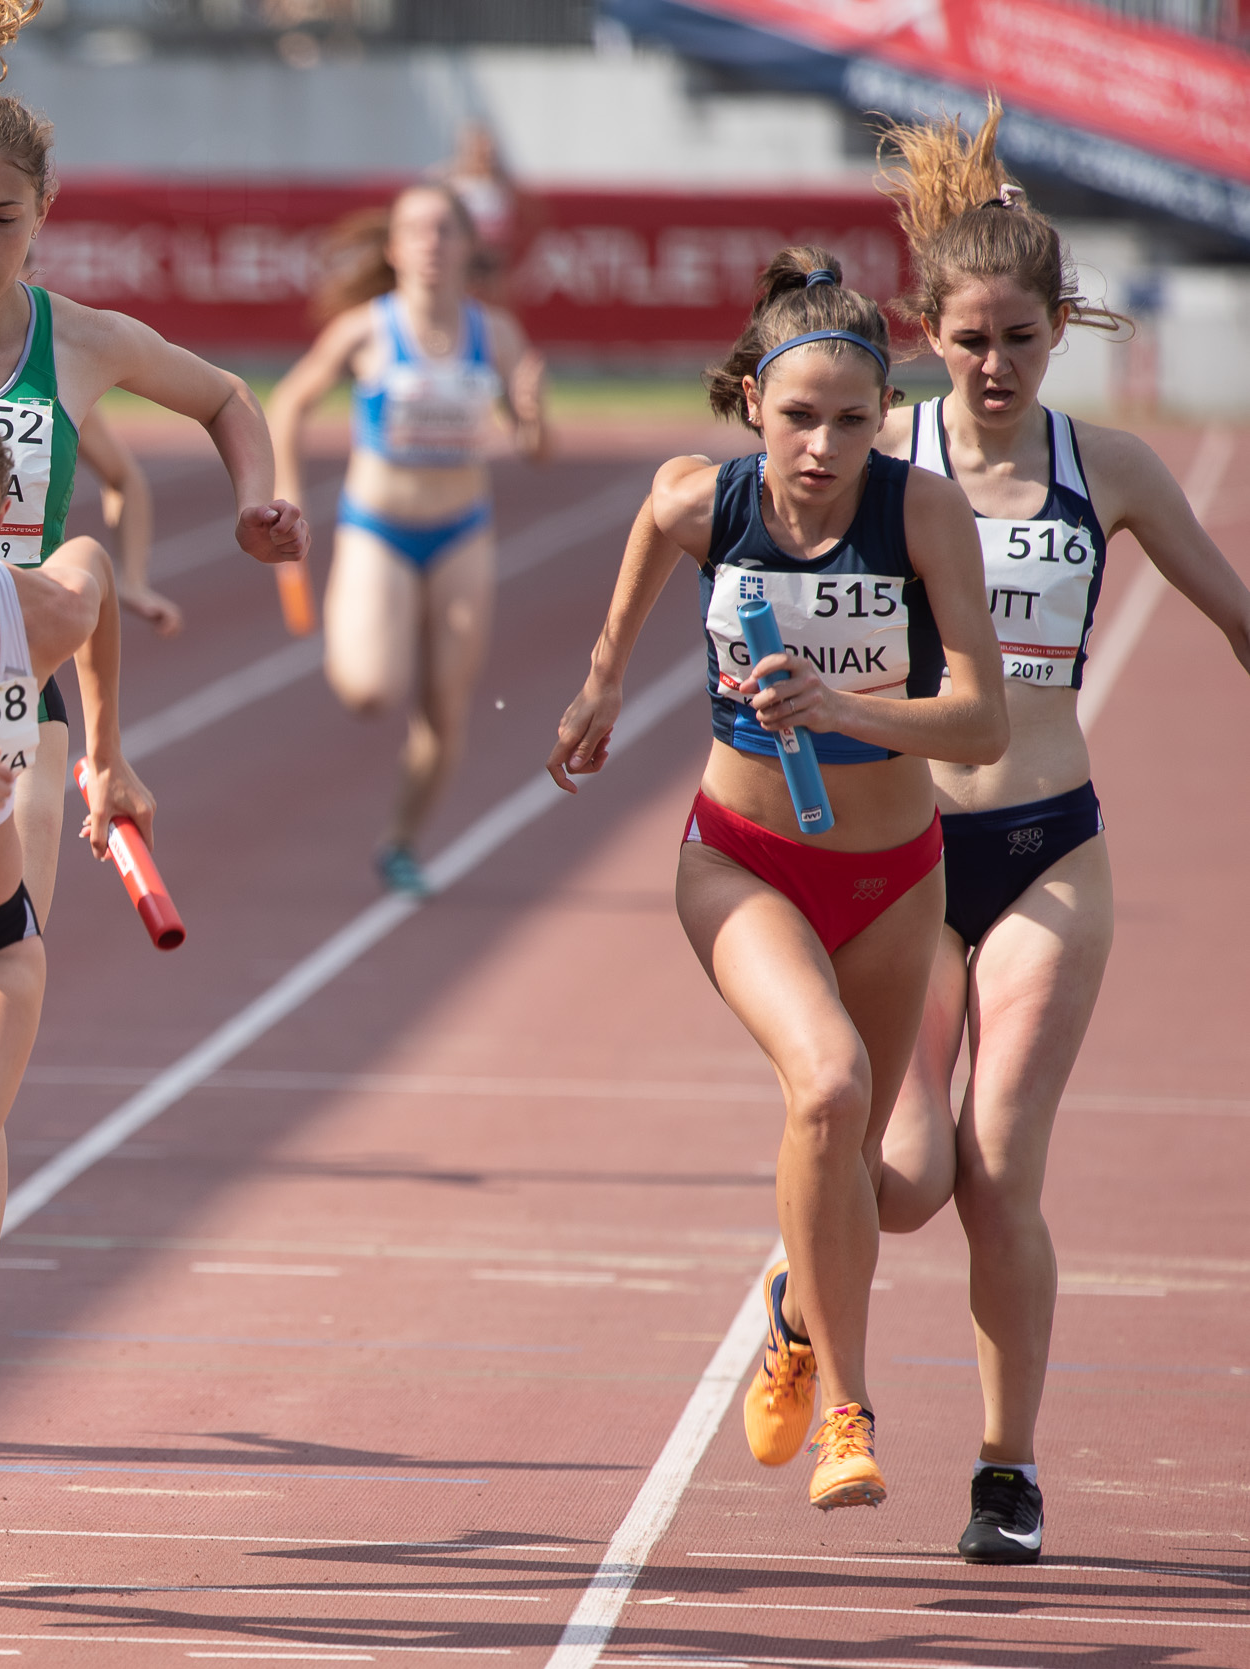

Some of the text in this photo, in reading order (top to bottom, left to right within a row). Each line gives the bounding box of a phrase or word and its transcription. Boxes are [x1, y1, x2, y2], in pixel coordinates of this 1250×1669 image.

[1007, 527, 1087, 565] 516
[814, 581, 897, 618] 515
[1011, 661, 1053, 680] 2019
